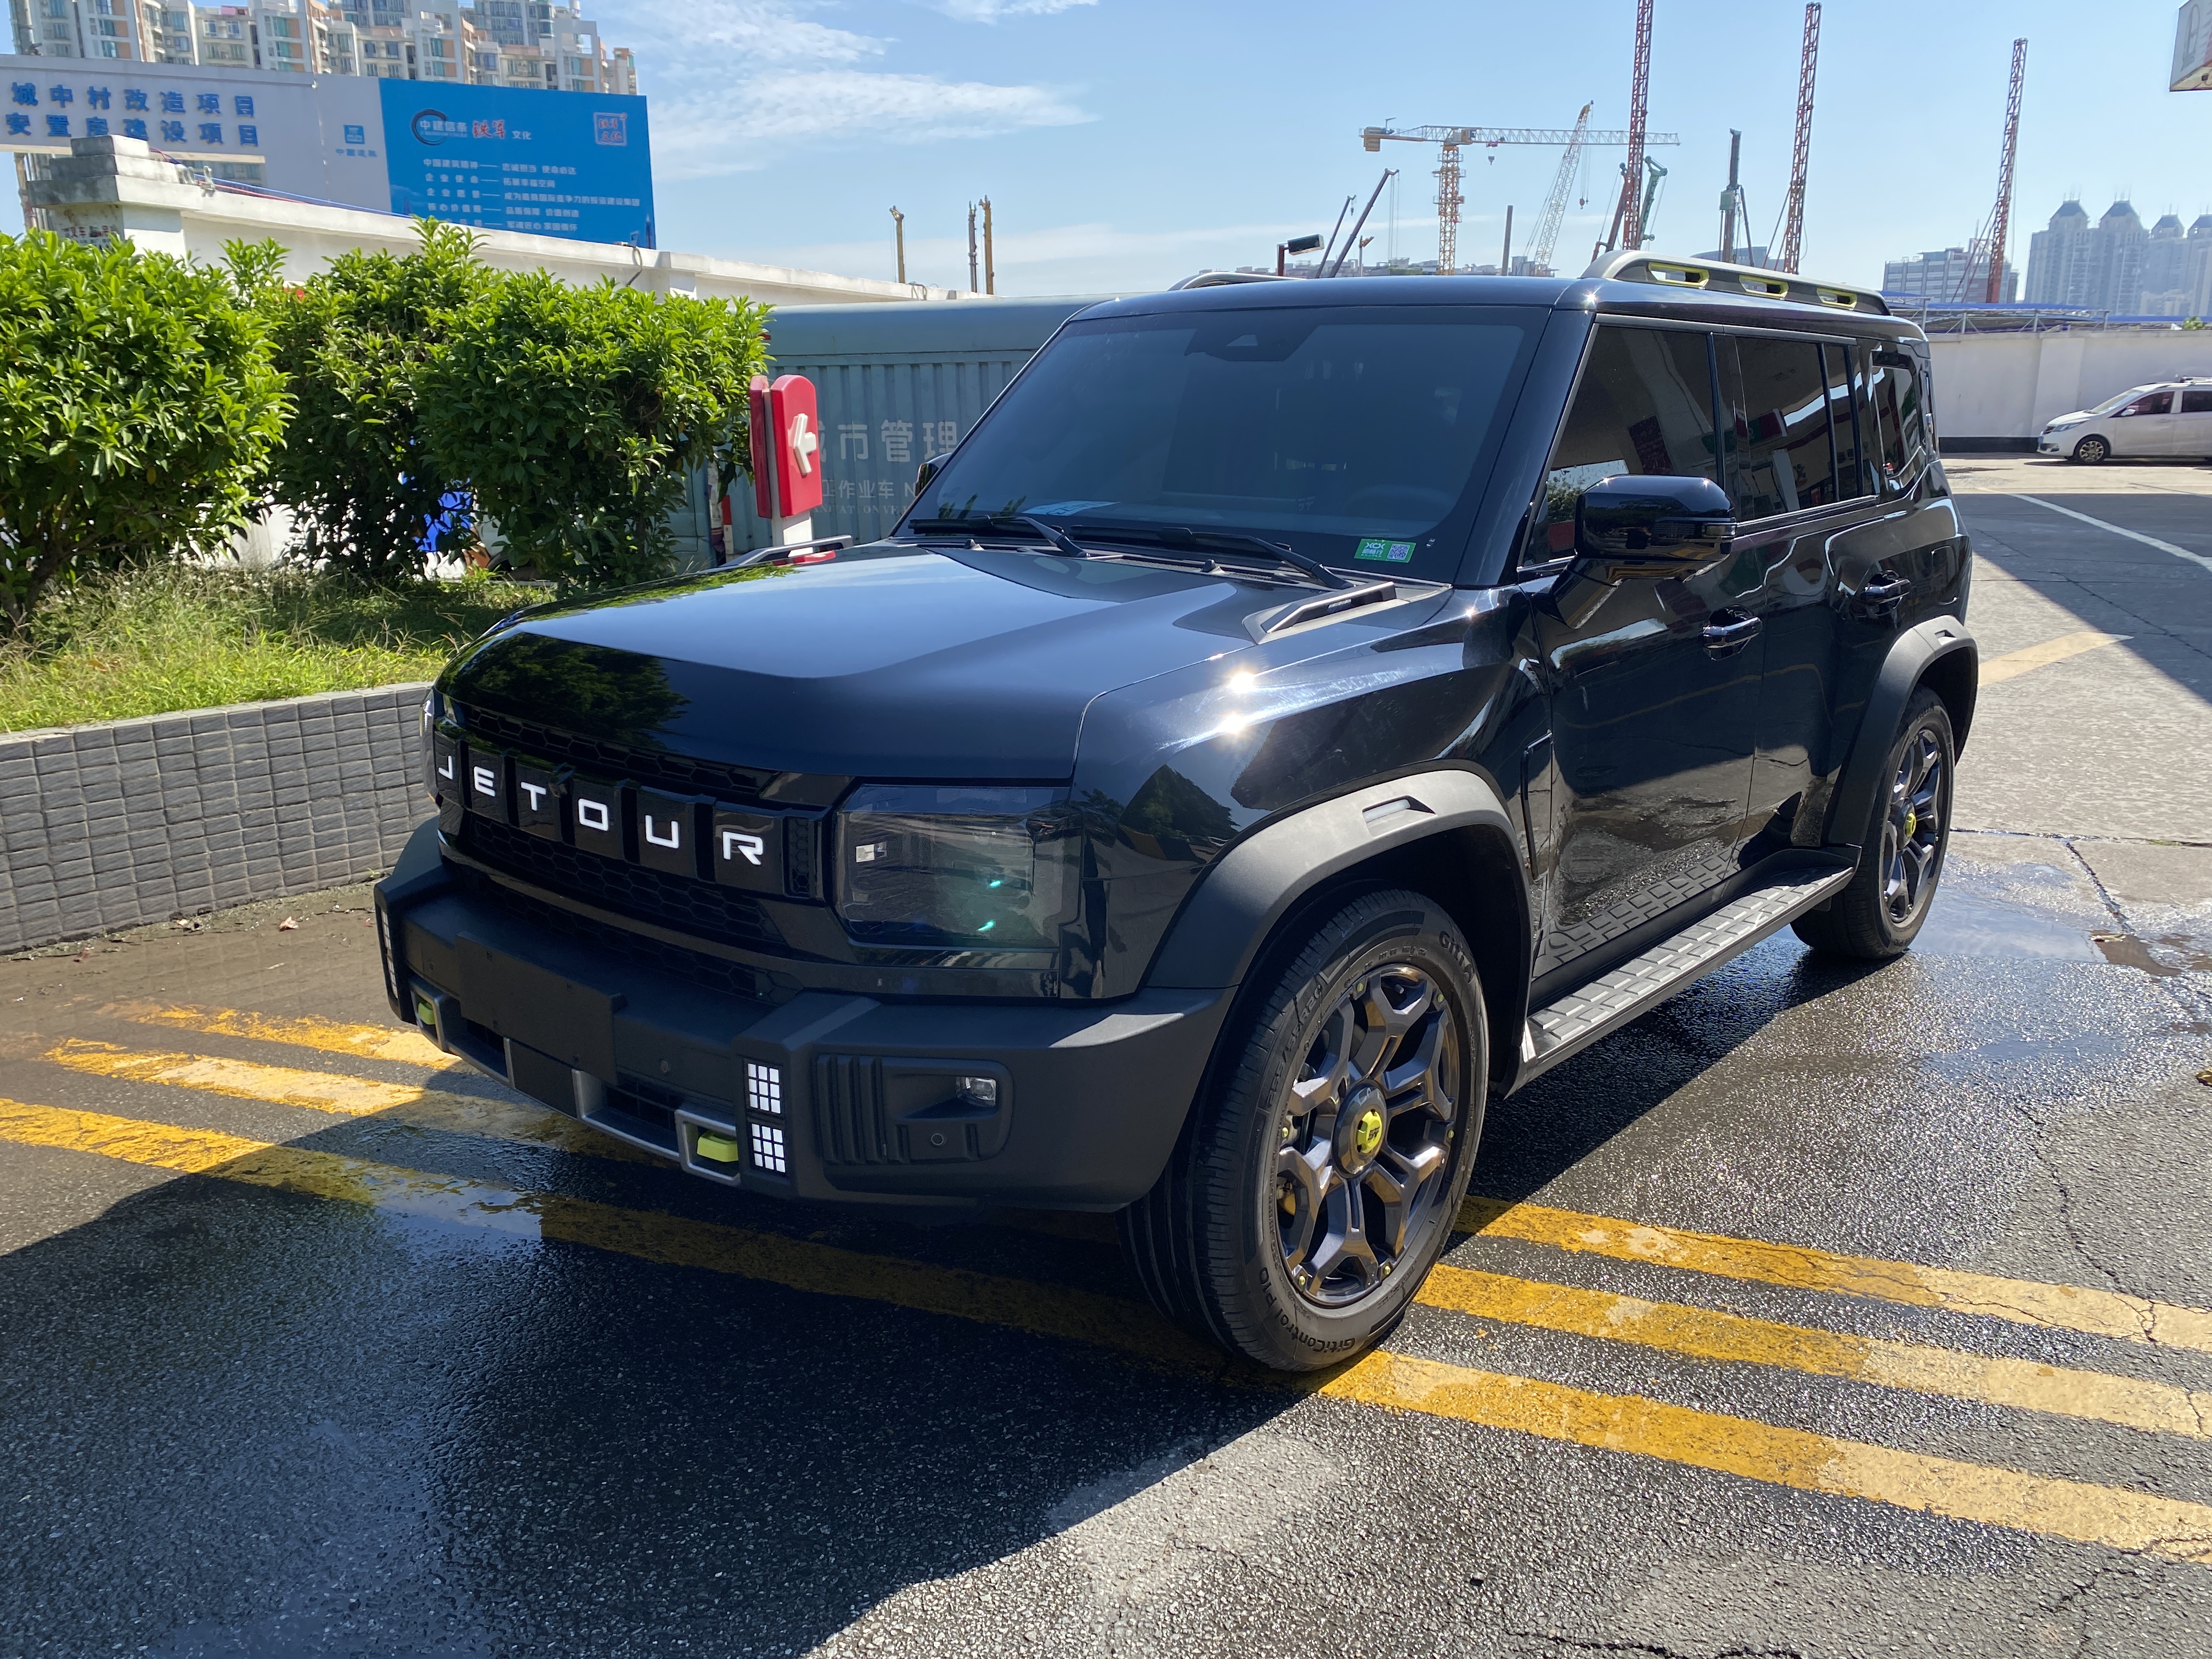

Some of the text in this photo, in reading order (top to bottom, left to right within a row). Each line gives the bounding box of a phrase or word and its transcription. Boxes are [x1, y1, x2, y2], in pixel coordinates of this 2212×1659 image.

[11, 81, 256, 118] 城中村改造项目
[5, 112, 259, 147] 安置房建设项目
[511, 129, 532, 140] 文化
[818, 419, 957, 462] 市管理
[438, 755, 764, 866] JETOUR
[1259, 1266, 1278, 1310] P10
[1276, 1308, 1356, 1354] GitiControl
